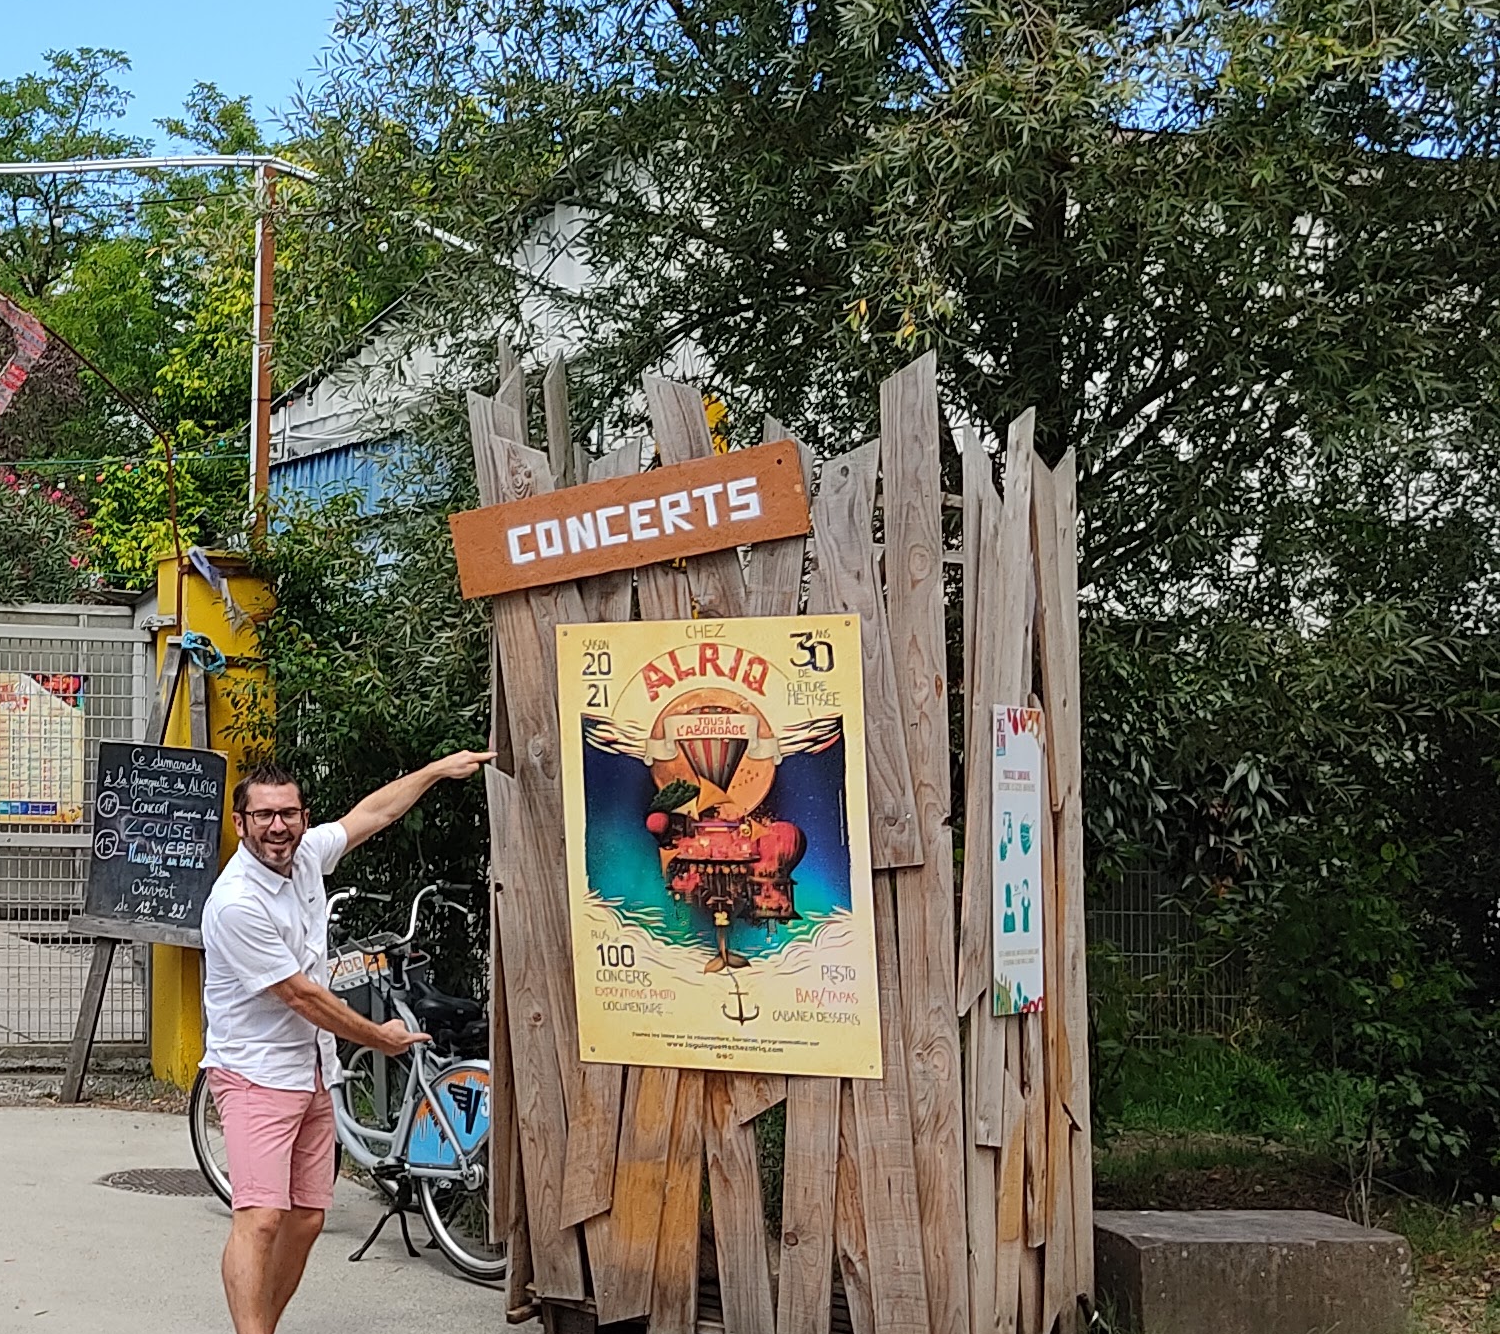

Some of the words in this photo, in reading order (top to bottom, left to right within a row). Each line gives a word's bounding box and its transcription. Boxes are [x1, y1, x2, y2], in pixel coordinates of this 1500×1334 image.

[507, 477, 762, 565] CONCERTS
[685, 624, 726, 639] CHEZ
[789, 631, 835, 673] 30
[582, 651, 612, 676] 20
[642, 642, 769, 702] ALRIQ
[586, 683, 610, 708] 21
[786, 680, 827, 693] CULTURE
[677, 725, 747, 736] L'ABORDAGE
[131, 747, 146, 767] Ce
[150, 750, 204, 773] dimanche
[124, 819, 193, 841] LOUISE
[151, 840, 205, 856] WEBER
[131, 878, 178, 900] Ouvert
[114, 893, 129, 912] de
[596, 943, 635, 968] 100
[596, 969, 652, 987] CONCERTS
